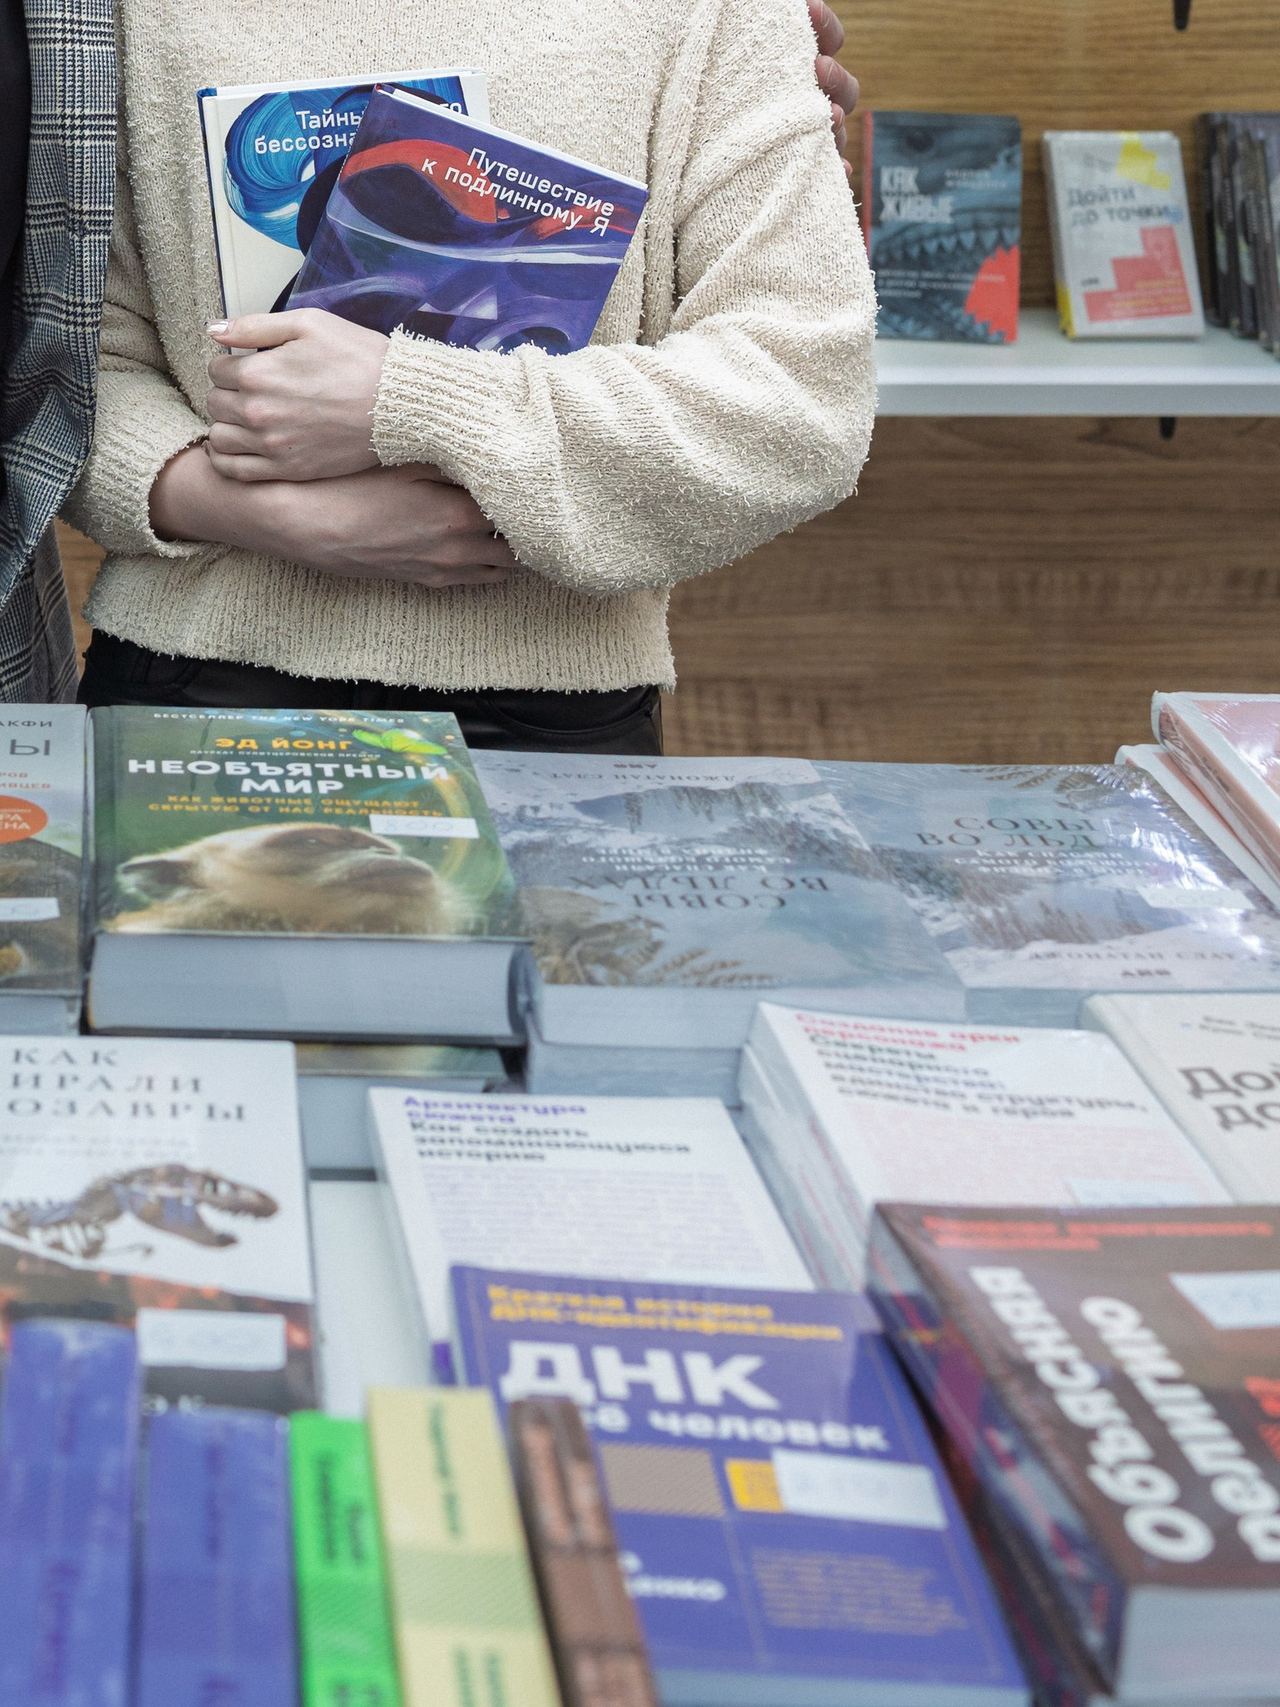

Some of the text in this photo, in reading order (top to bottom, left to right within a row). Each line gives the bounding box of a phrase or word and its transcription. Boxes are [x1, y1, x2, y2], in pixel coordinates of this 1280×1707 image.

[467, 147, 615, 218] Путешествие
[880, 164, 919, 193] КАК
[421, 157, 610, 238] к подлинному Я
[880, 194, 954, 224] ЖИВЫЕ
[153, 713, 245, 721] БЕСТСЕЛЛЕР
[214, 736, 353, 751] ЭД ЙОНГ
[128, 758, 449, 781] НЕОБЪЯТНЫЙ
[240, 778, 345, 795] МИР
[148, 803, 444, 818] СКРЫТУЮ ОТ НАС РЕАЛЬНОСТЬ
[167, 795, 420, 809] КАК ЖИВОТНЫЕ ОЩУЩАЮТ
[954, 817, 1098, 833] СОВЫ
[913, 831, 1105, 850] ВО ЛЬД
[569, 874, 830, 892] ВО ЛЬДАХ
[632, 893, 787, 909] СОВЫ
[796, 1012, 1021, 1044] Создание арки
[804, 1025, 966, 1052] персонажа
[810, 1034, 936, 1060] Секреты
[13, 1048, 118, 1068] КАК
[1179, 1066, 1280, 1099] До
[405, 1096, 586, 1115] Архитектура
[407, 1111, 516, 1125] сюжета
[411, 1121, 588, 1138] Как создать
[415, 1135, 691, 1155] запоминающуюся
[418, 1149, 545, 1163] историю
[499, 1339, 782, 1411] ДНК
[649, 1409, 891, 1452] человек
